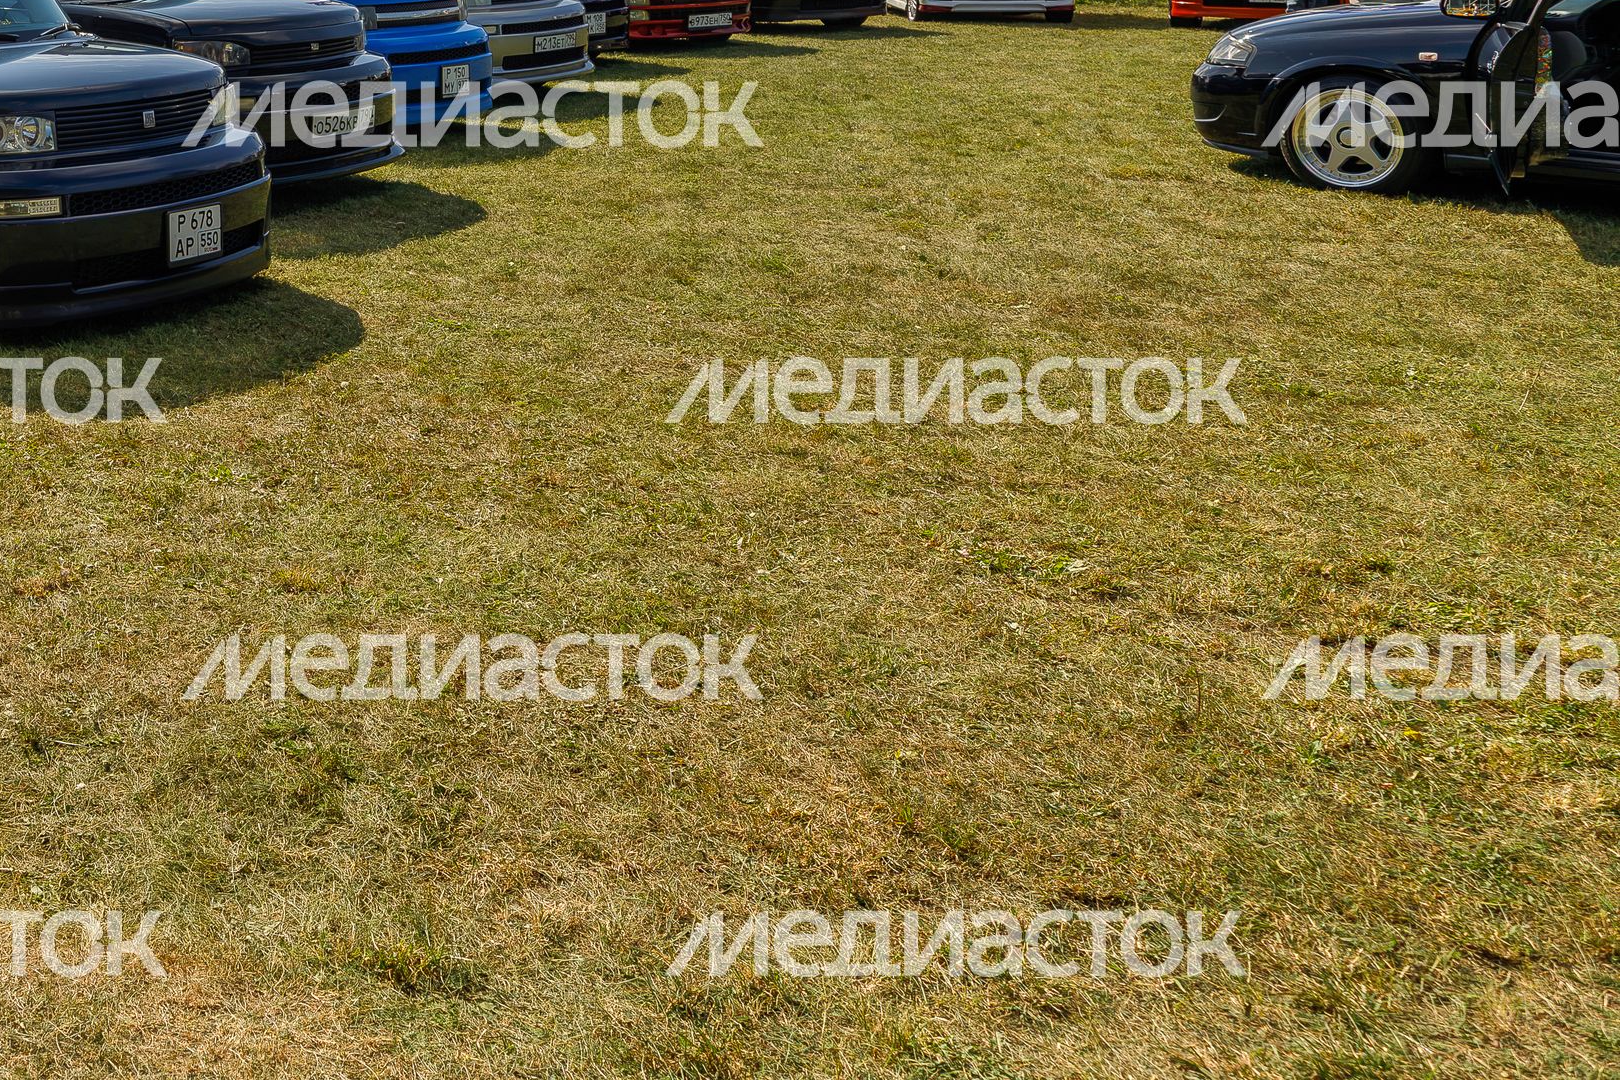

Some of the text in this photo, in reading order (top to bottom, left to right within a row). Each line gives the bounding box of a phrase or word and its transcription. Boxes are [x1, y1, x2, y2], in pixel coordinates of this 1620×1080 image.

[178, 209, 213, 233] Р 678
[175, 231, 218, 258] АР 550
